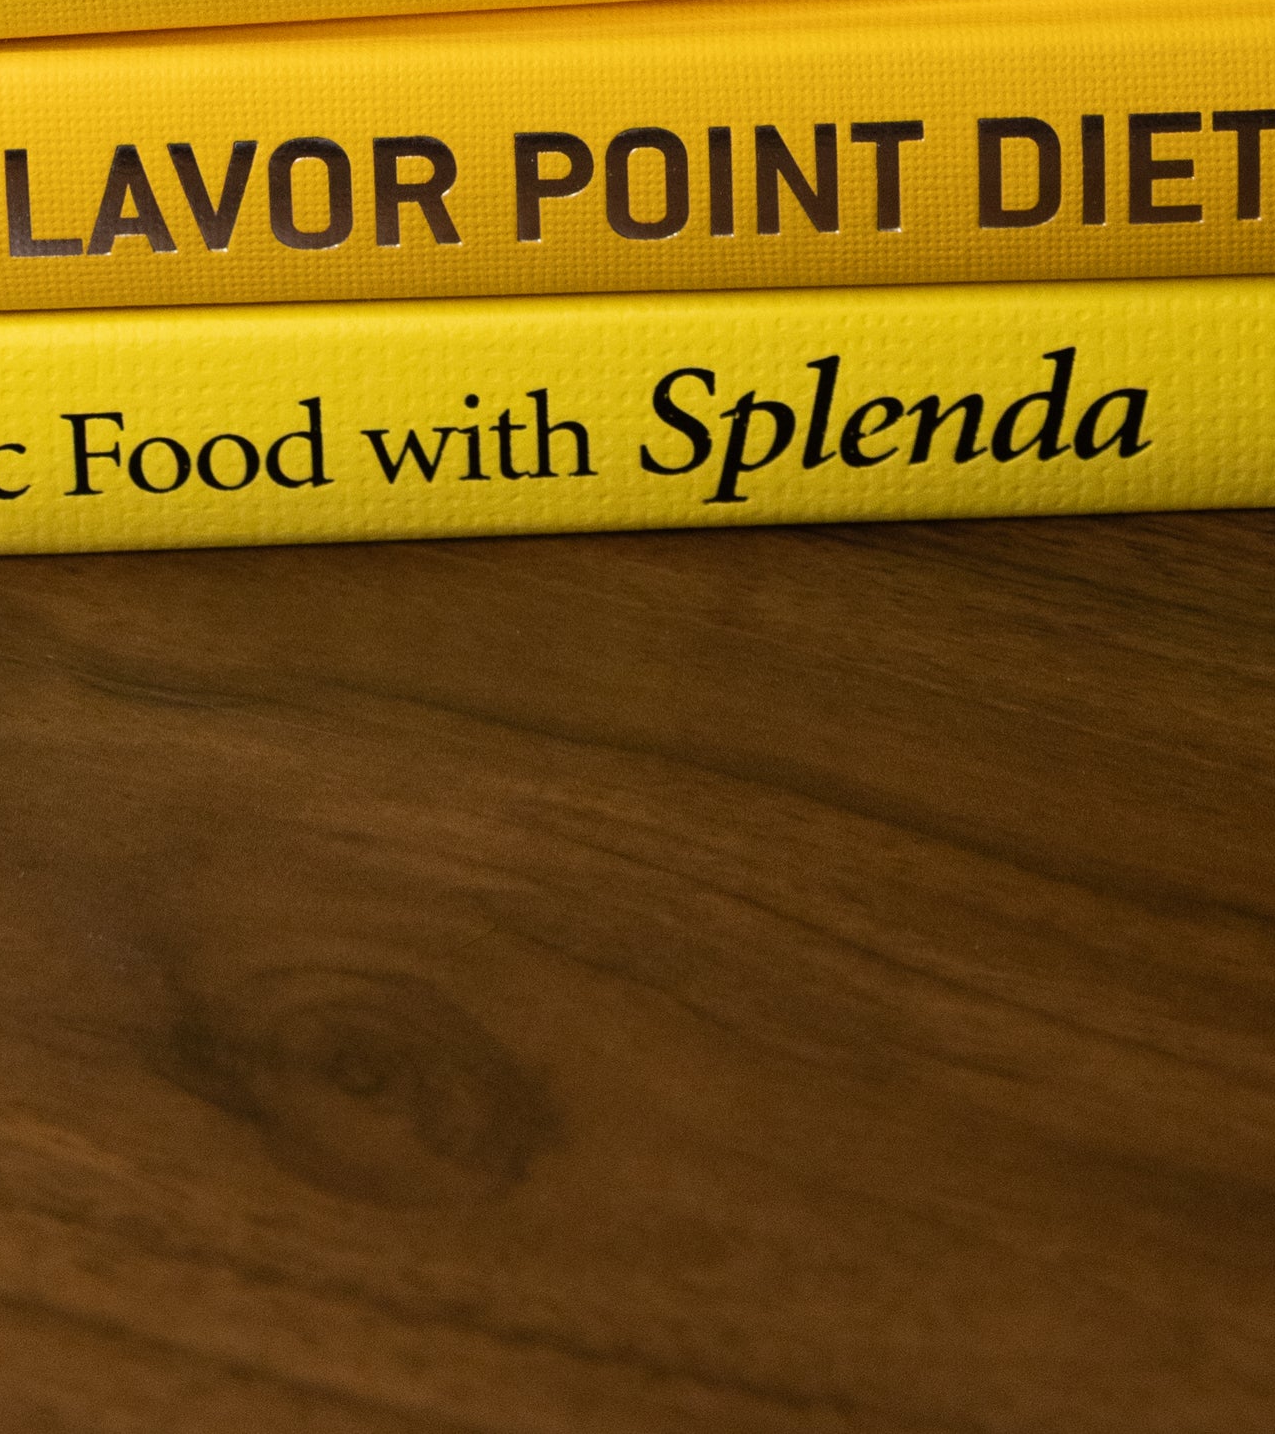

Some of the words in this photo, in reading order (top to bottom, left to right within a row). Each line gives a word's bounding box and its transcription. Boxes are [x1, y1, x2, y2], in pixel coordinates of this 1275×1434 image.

[513, 120, 924, 243] POINT
[60, 396, 334, 497] Food
[361, 388, 599, 484] with
[639, 346, 1152, 505] Splenda
